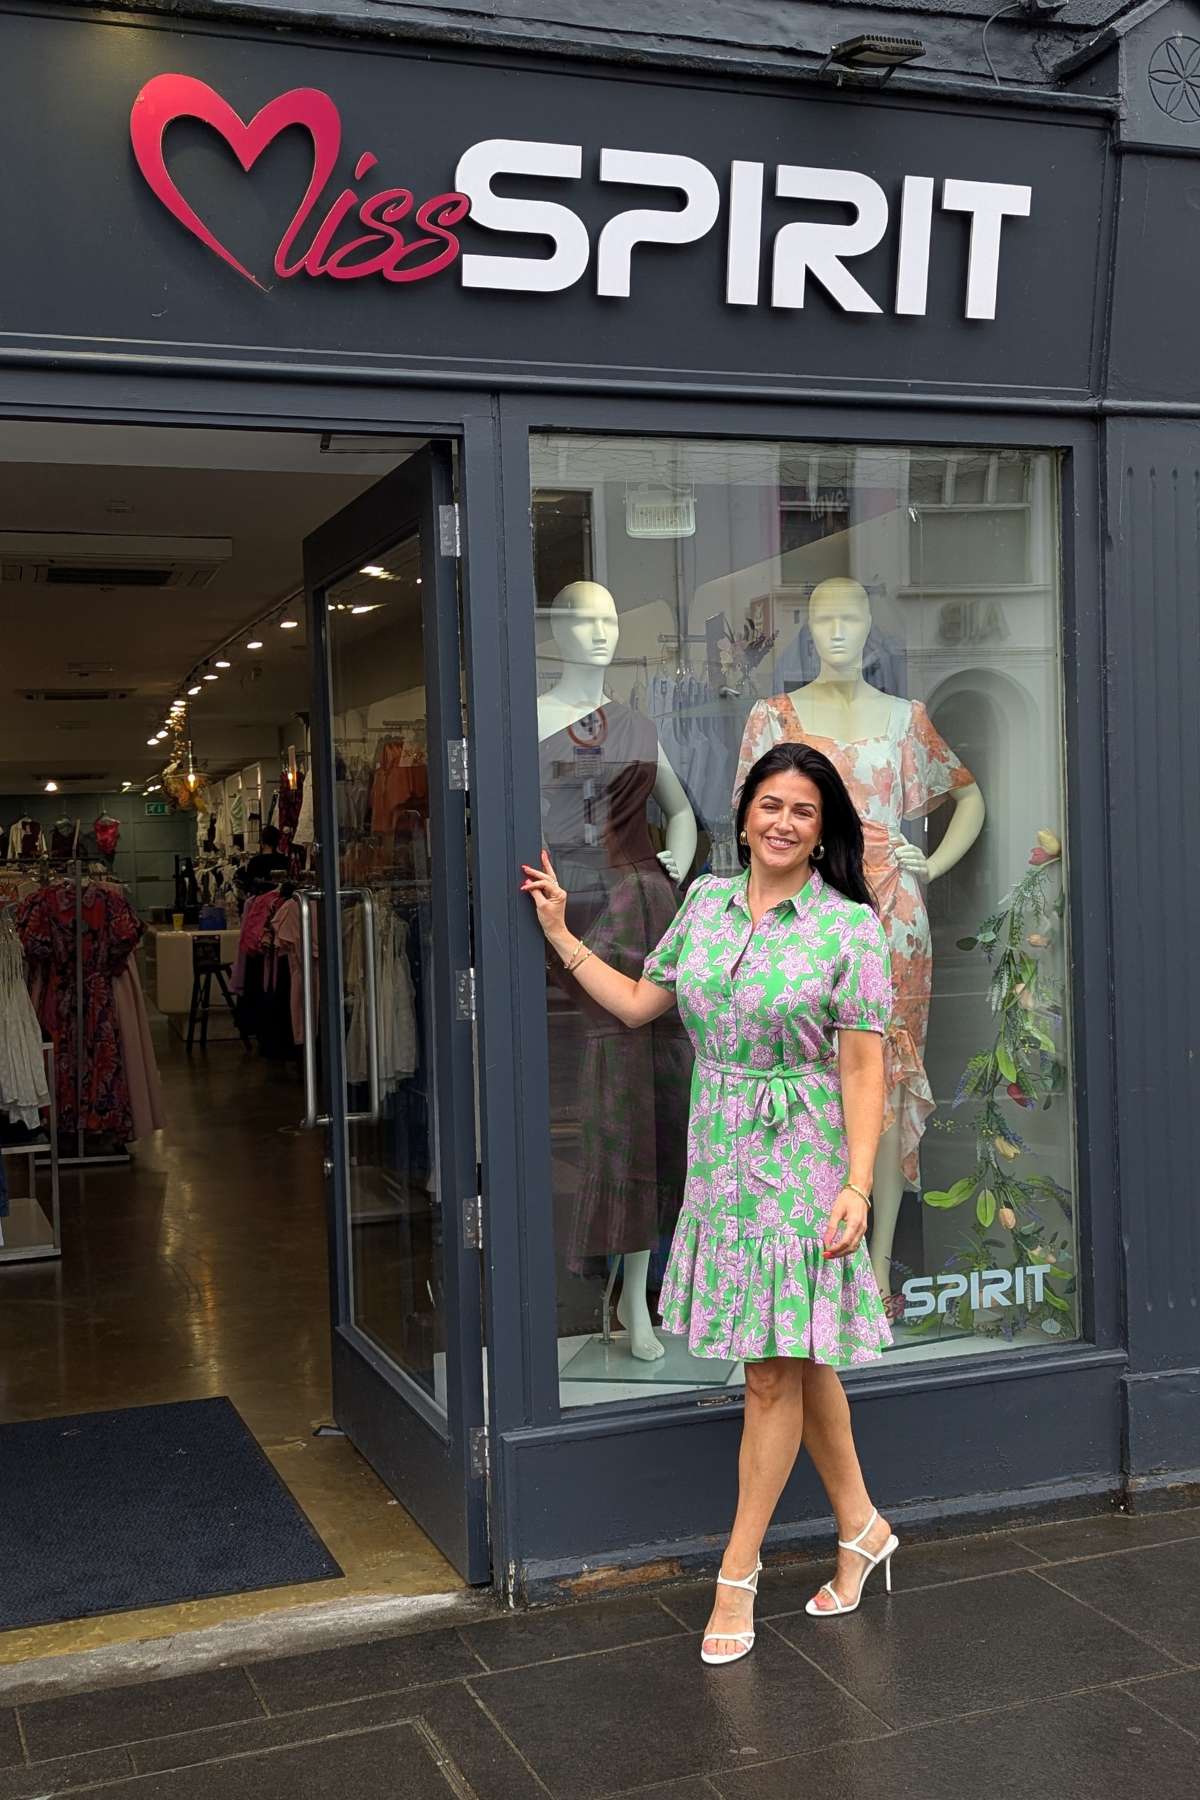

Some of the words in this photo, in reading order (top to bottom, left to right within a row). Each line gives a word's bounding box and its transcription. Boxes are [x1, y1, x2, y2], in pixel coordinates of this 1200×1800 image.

[130, 72, 472, 294] Miss
[454, 138, 1033, 320] SPIRIT
[902, 1263, 1051, 1318] SPIRIT
